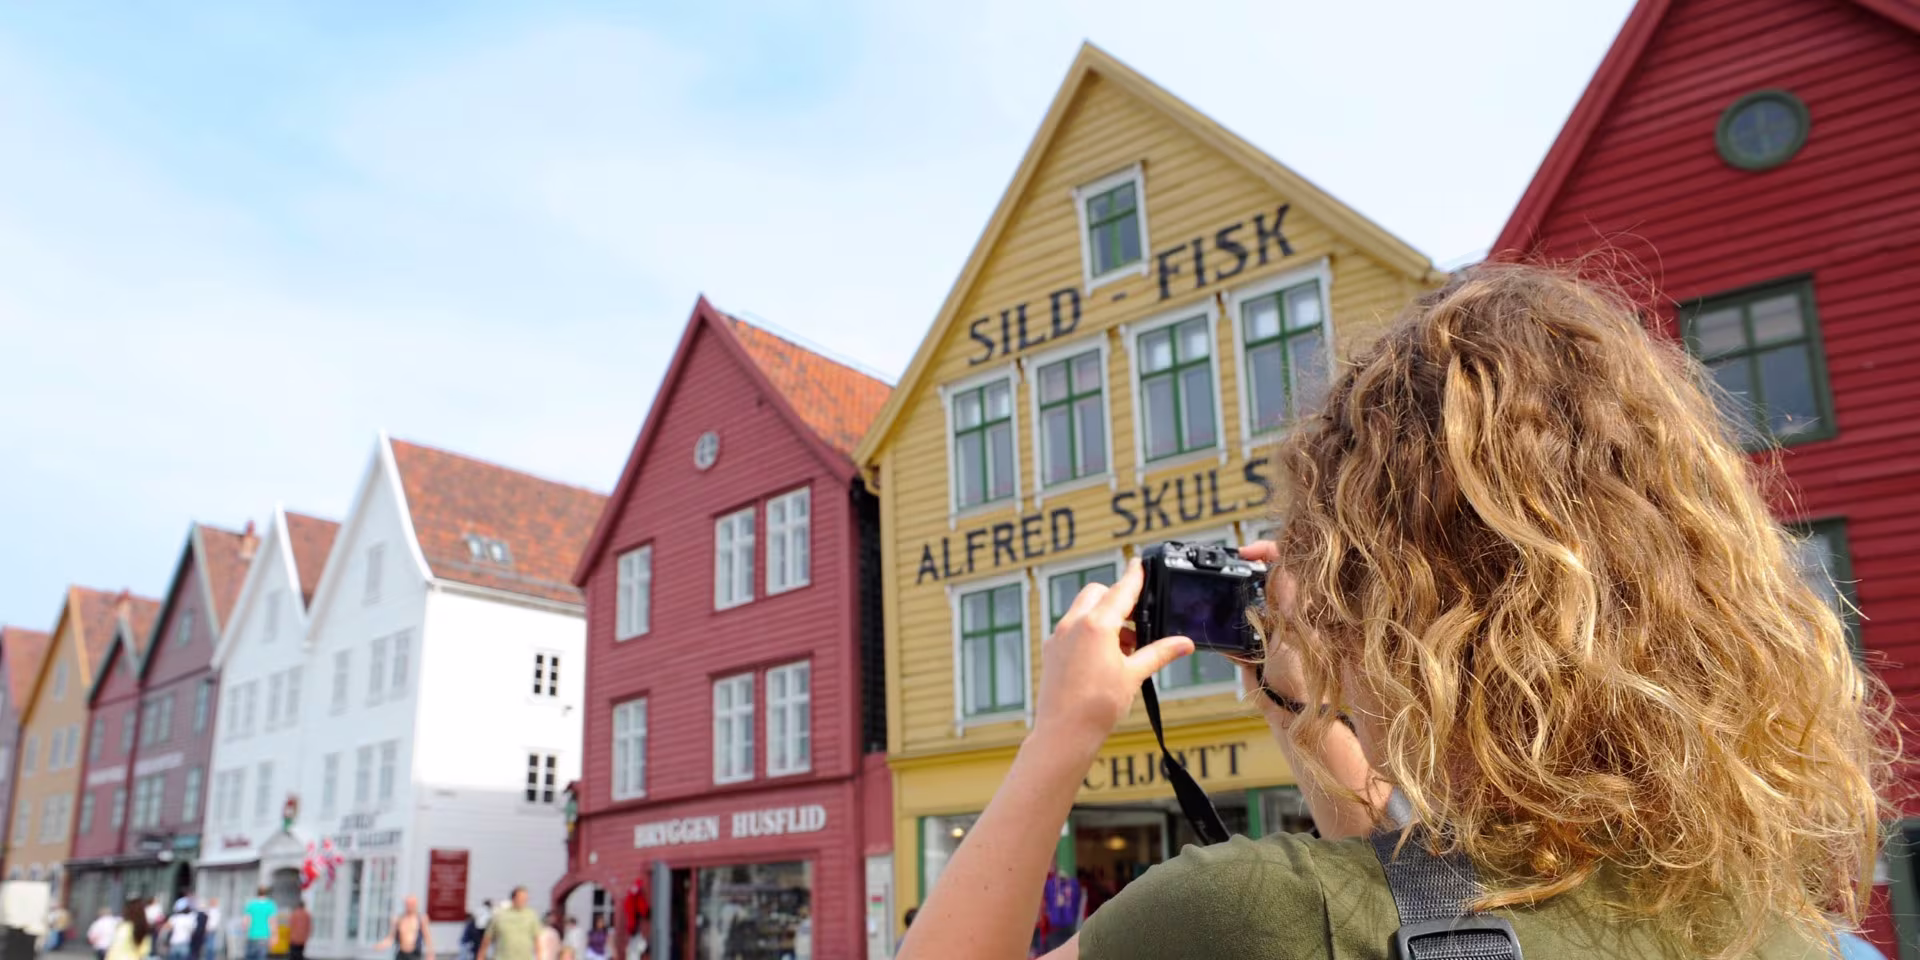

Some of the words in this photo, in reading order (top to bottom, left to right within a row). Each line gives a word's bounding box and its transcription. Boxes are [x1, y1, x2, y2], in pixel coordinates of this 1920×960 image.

[968, 288, 1081, 366] SILD
[1157, 203, 1294, 301] FISK
[916, 507, 1075, 585] ALFRED
[731, 804, 826, 839] HUSFLID
